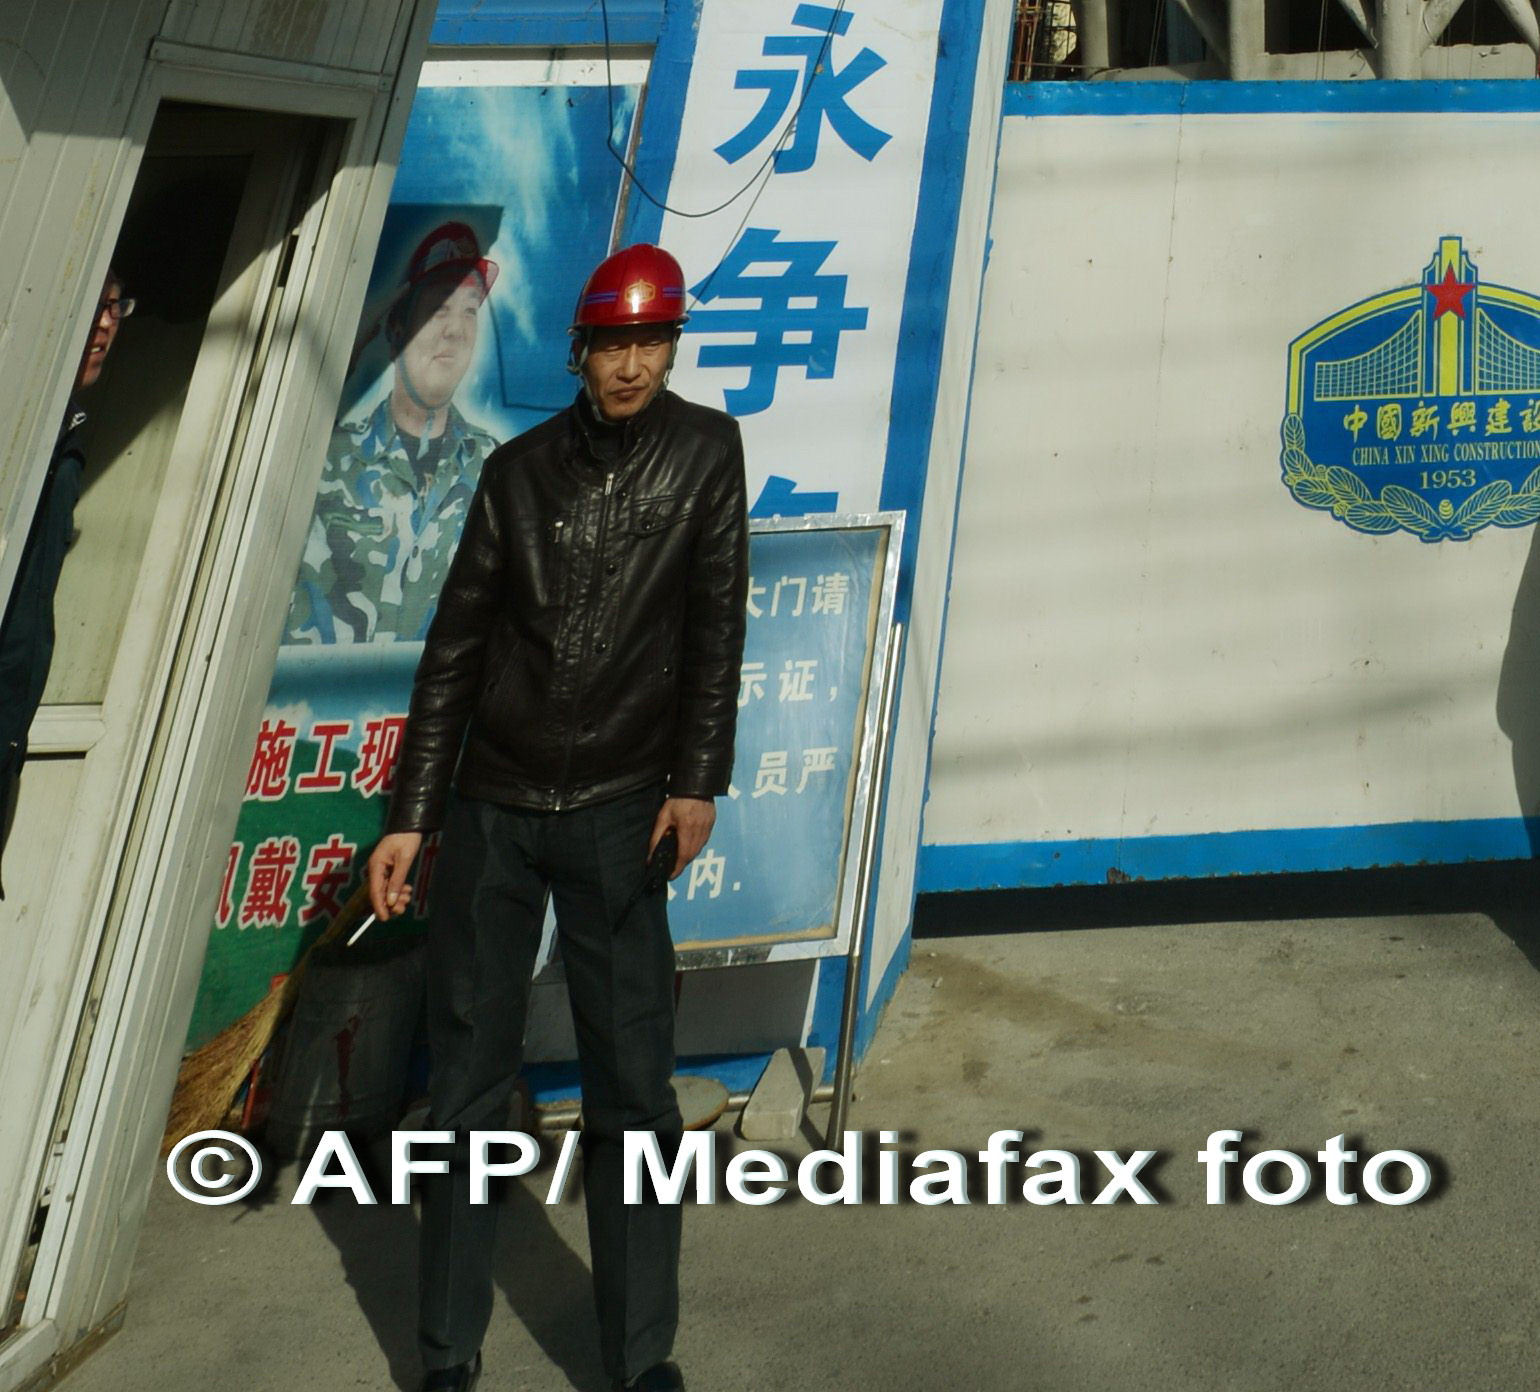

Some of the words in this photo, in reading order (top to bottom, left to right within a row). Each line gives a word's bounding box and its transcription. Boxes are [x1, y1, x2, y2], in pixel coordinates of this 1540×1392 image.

[687, 3, 893, 516] 永争
[1352, 447, 1389, 466] CHINA
[1394, 447, 1416, 464] XIN
[1421, 445, 1449, 463] XING
[1419, 470, 1477, 489] 1953
